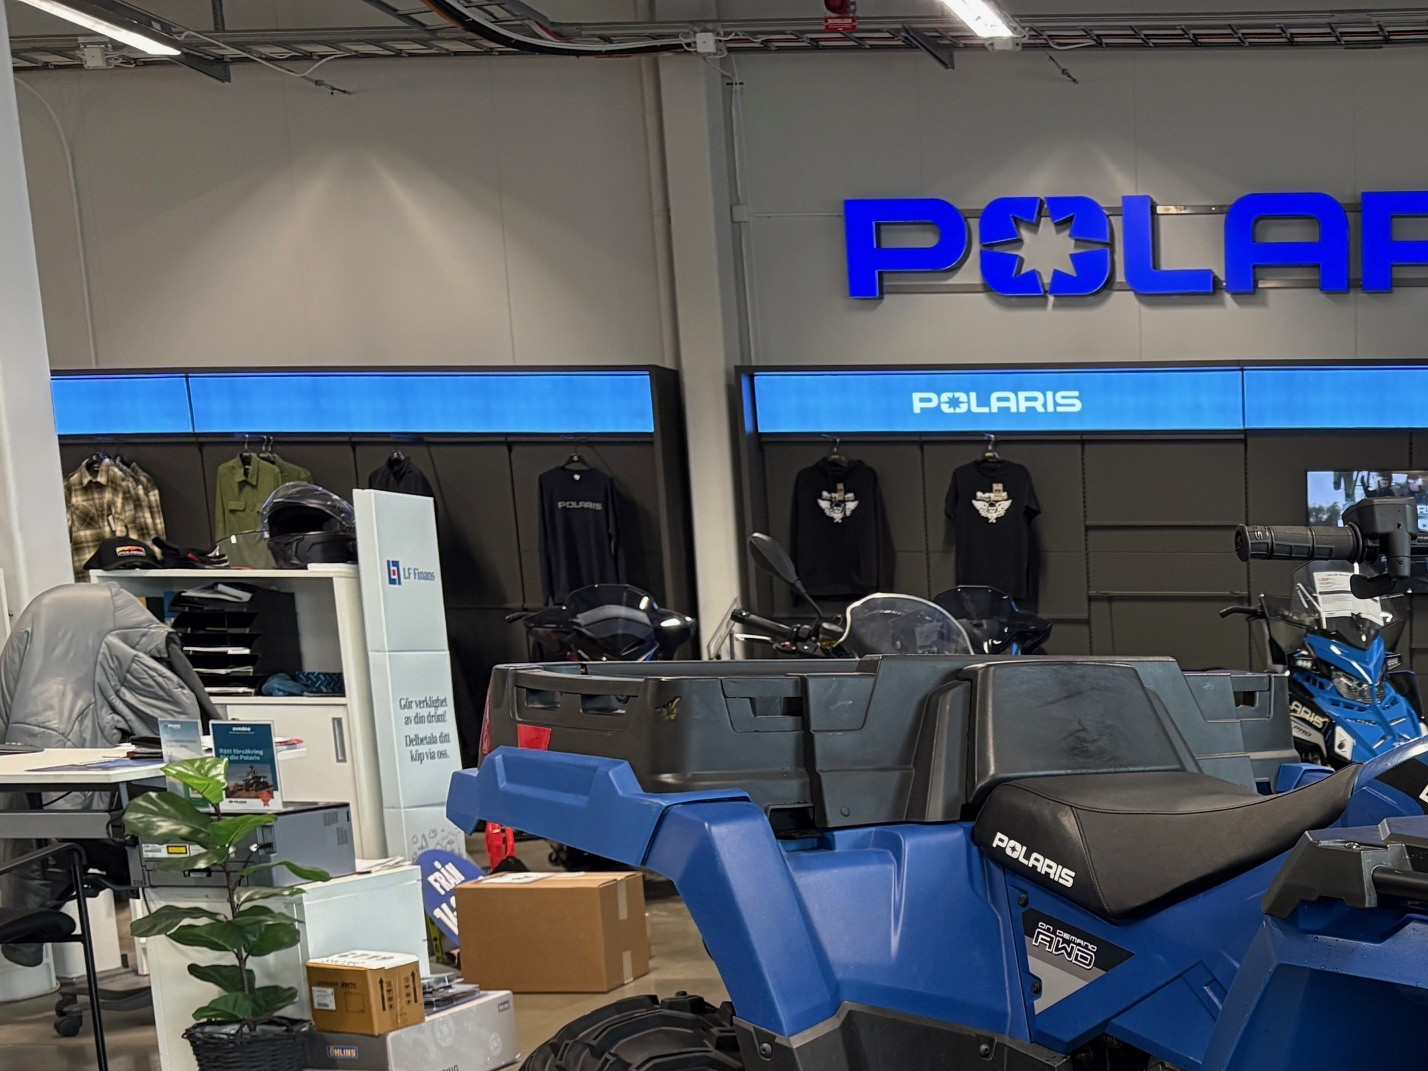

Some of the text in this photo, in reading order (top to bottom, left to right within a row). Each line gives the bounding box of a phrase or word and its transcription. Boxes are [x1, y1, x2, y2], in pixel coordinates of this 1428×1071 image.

[912, 391, 1082, 414] POLARIS
[558, 501, 602, 511] POLARIS
[403, 567, 436, 581] LF Finans
[399, 695, 448, 712] Gör verklighet
[404, 716, 412, 725] av
[413, 712, 426, 725] din
[1289, 701, 1329, 729] ARIS
[405, 733, 438, 748] Delbetala
[410, 749, 424, 764] köp
[424, 748, 437, 761] via
[992, 832, 1076, 888] POLARIS
[427, 860, 465, 895] FRÅN
[1032, 928, 1095, 970] AWD
